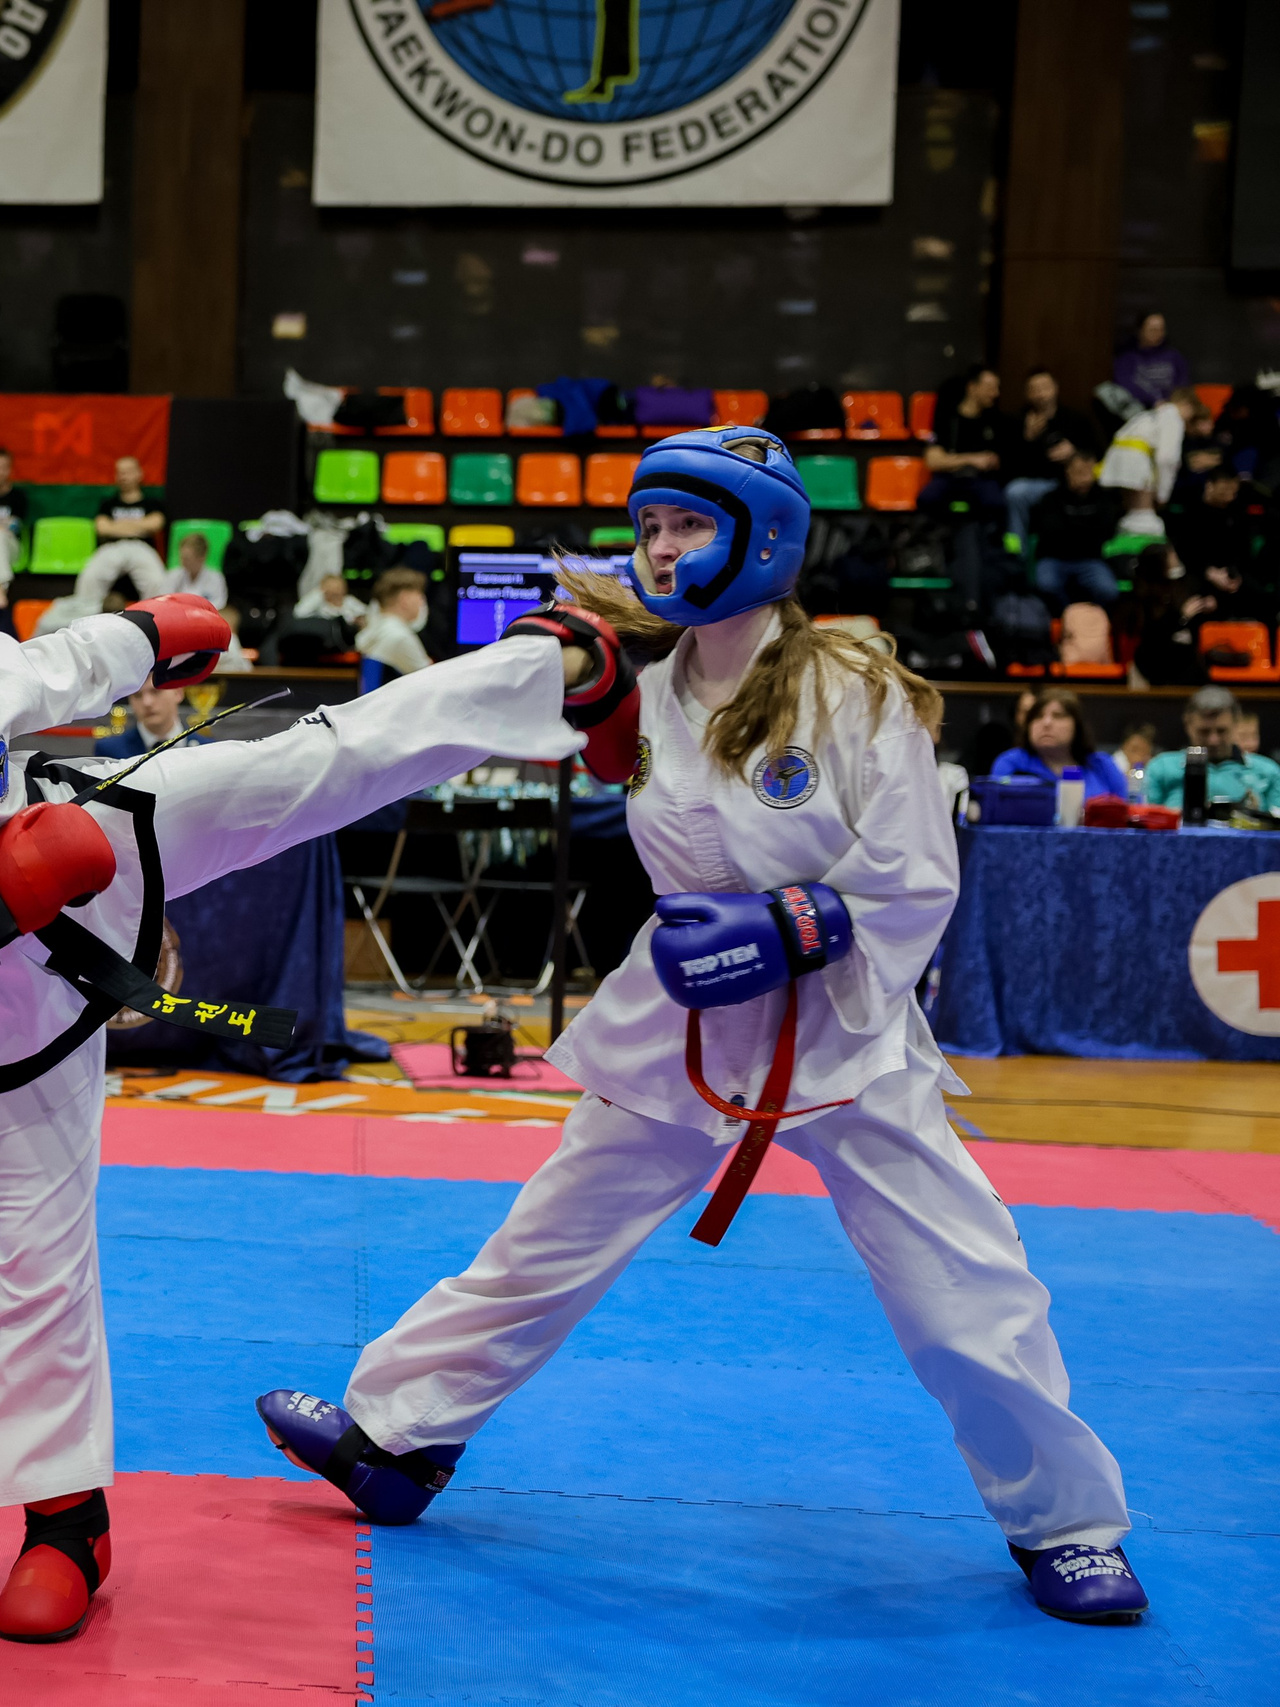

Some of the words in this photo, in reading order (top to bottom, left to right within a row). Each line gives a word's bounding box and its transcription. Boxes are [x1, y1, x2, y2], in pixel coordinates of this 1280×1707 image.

[371, 0, 604, 167] AEKWON-DO
[622, 0, 847, 164] FEDERATIO
[678, 955, 719, 977] TOP
[716, 942, 761, 968] TEN
[1054, 1556, 1092, 1577] TOP
[1088, 1555, 1129, 1573] TEN
[1074, 1566, 1123, 1581] FIGHT
